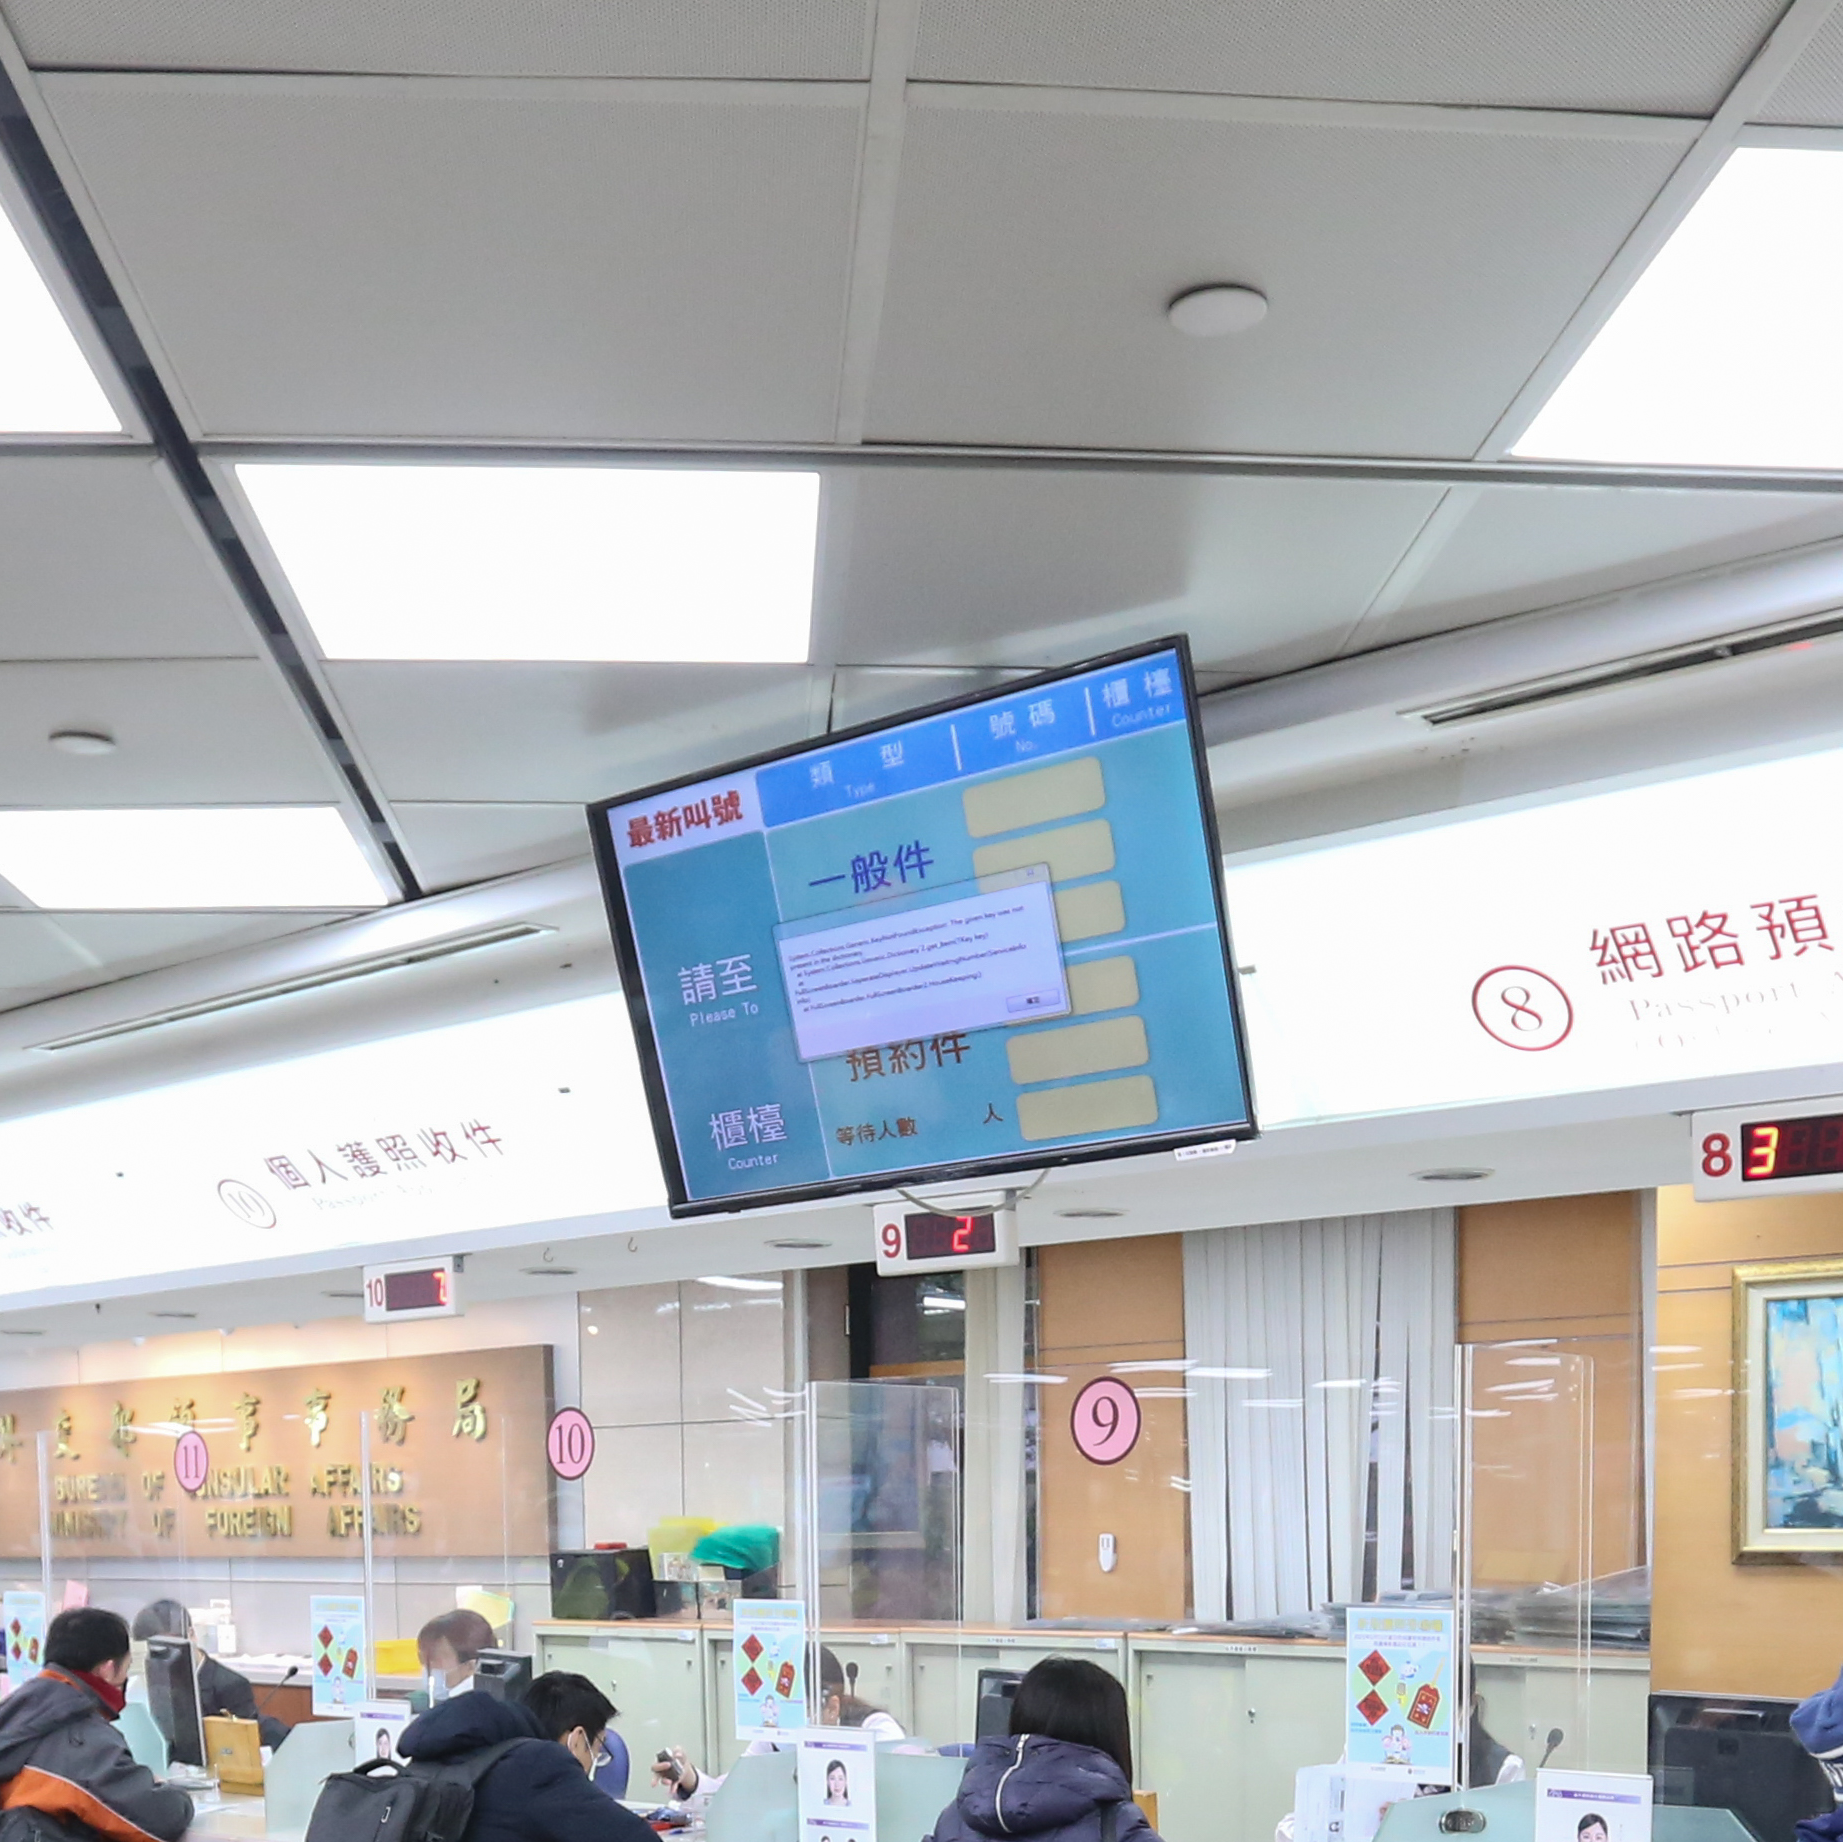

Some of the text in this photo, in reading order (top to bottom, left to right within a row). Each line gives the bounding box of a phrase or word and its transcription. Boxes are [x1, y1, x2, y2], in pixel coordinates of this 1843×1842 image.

[989, 699, 1056, 739] 號碼
[1112, 703, 1172, 728] Counter
[845, 782, 875, 798] Type
[626, 790, 744, 848] 最新叫號
[809, 839, 935, 894] 一般件
[677, 953, 758, 1006] 請至
[690, 1002, 759, 1027] Please To
[845, 1031, 972, 1083] 預約件
[708, 1103, 789, 1152] 櫃檯
[983, 1102, 1004, 1124] 人
[835, 1117, 918, 1147] 等待人數
[264, 1118, 504, 1190] 個人護照收件
[727, 1152, 779, 1171] Counter
[1701, 1132, 1733, 1178] 8
[881, 1223, 902, 1258] 9
[366, 1278, 384, 1308] 10
[310, 1463, 405, 1499] AFFARS
[205, 1504, 293, 1538] FOREIGN
